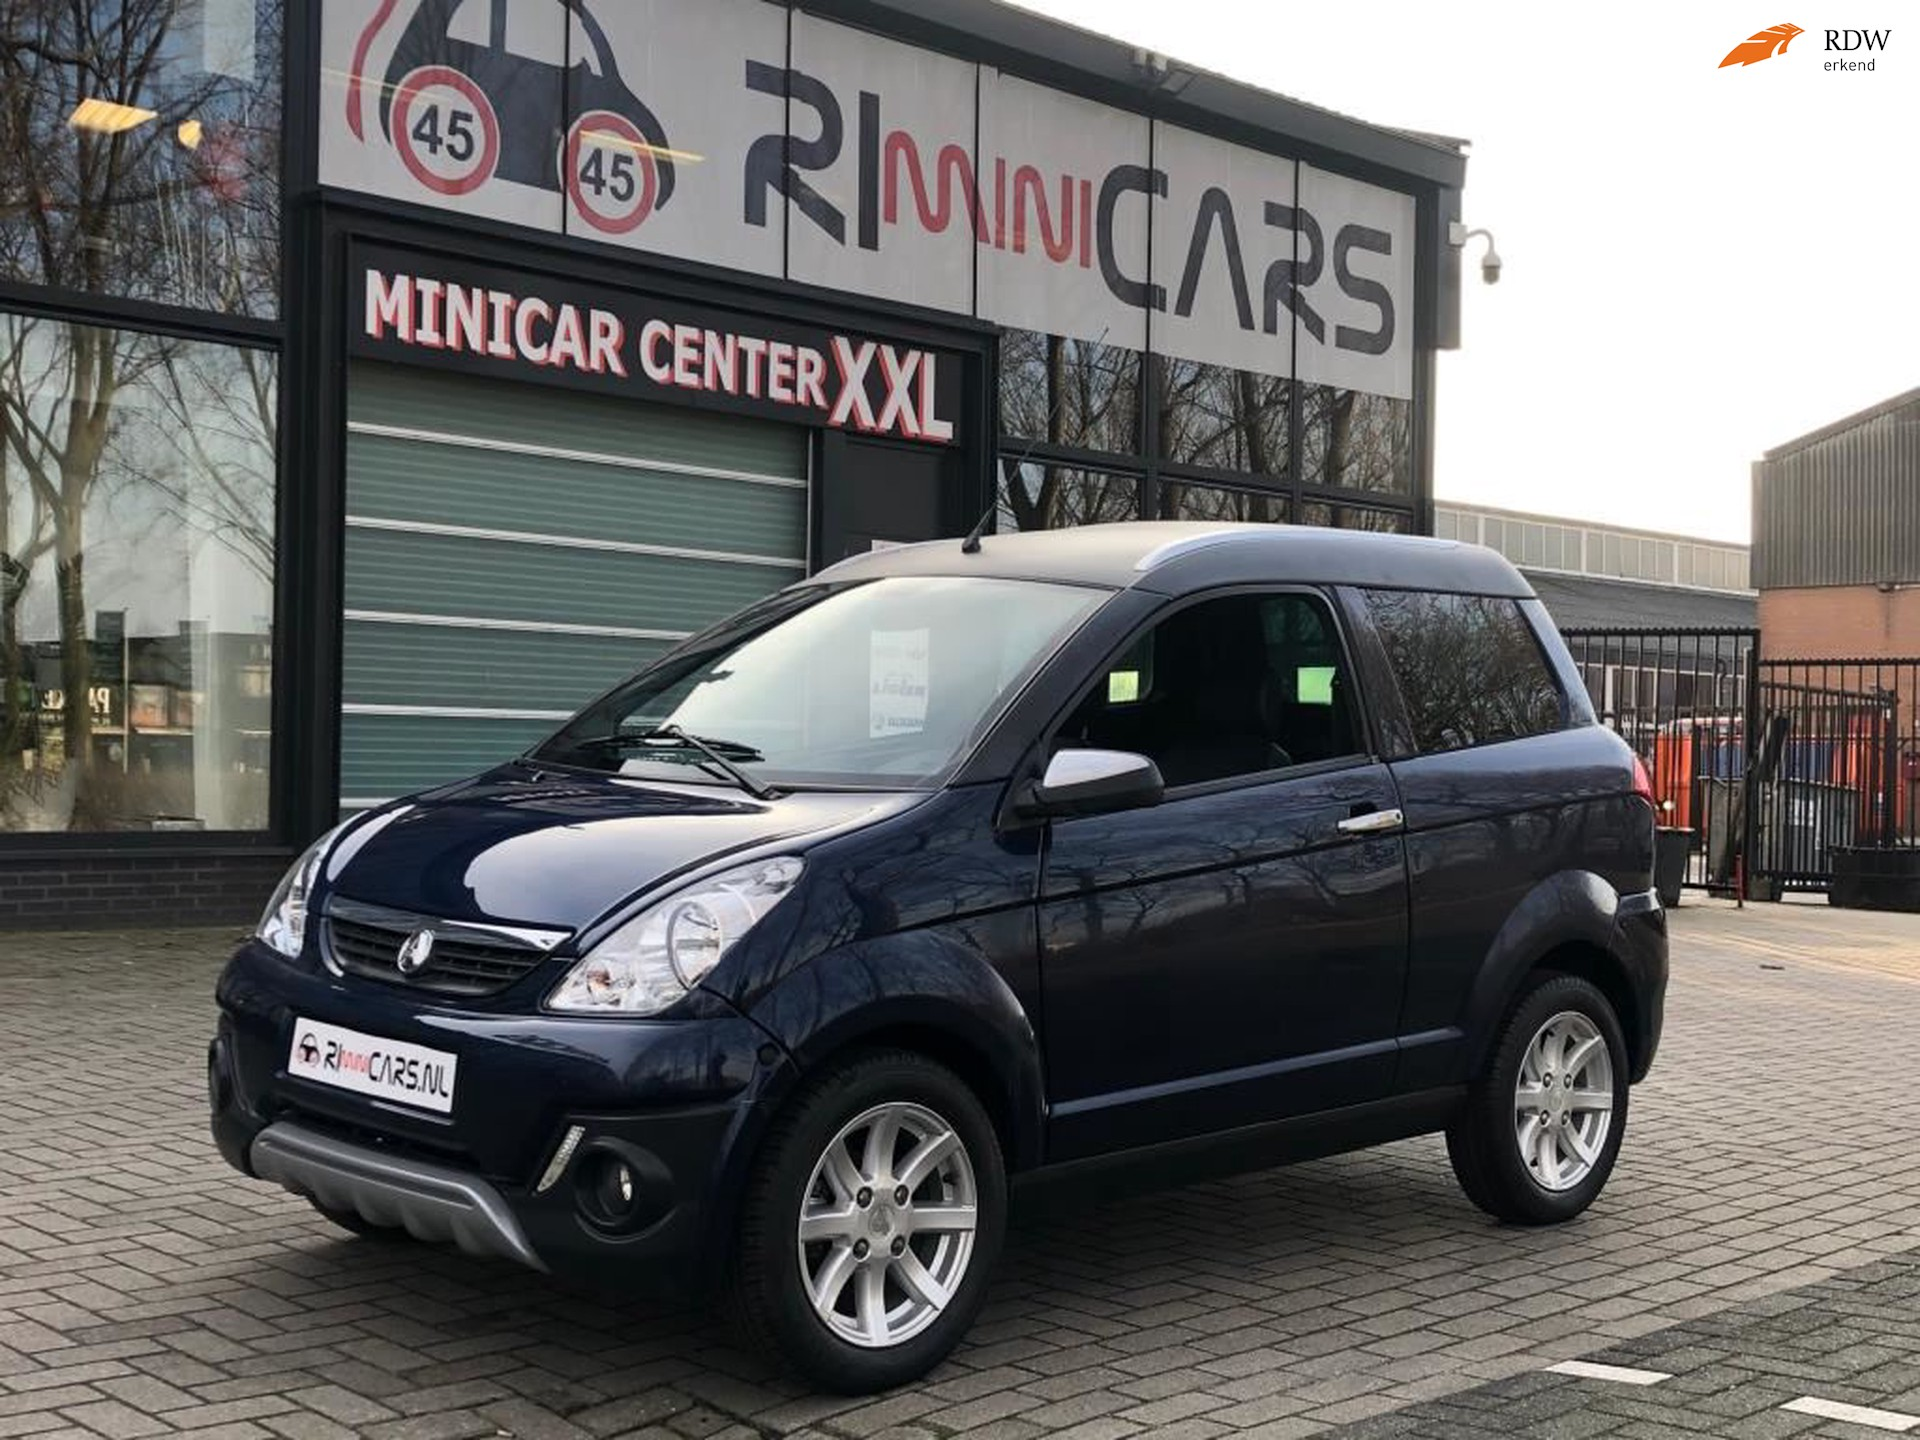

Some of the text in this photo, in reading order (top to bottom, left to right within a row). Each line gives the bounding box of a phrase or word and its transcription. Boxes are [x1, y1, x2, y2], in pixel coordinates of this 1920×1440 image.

[412, 104, 475, 161] 45
[580, 148, 636, 202] 45
[744, 58, 1395, 356] RIMINICARS
[365, 269, 953, 440] MINICAR CENTER XXL
